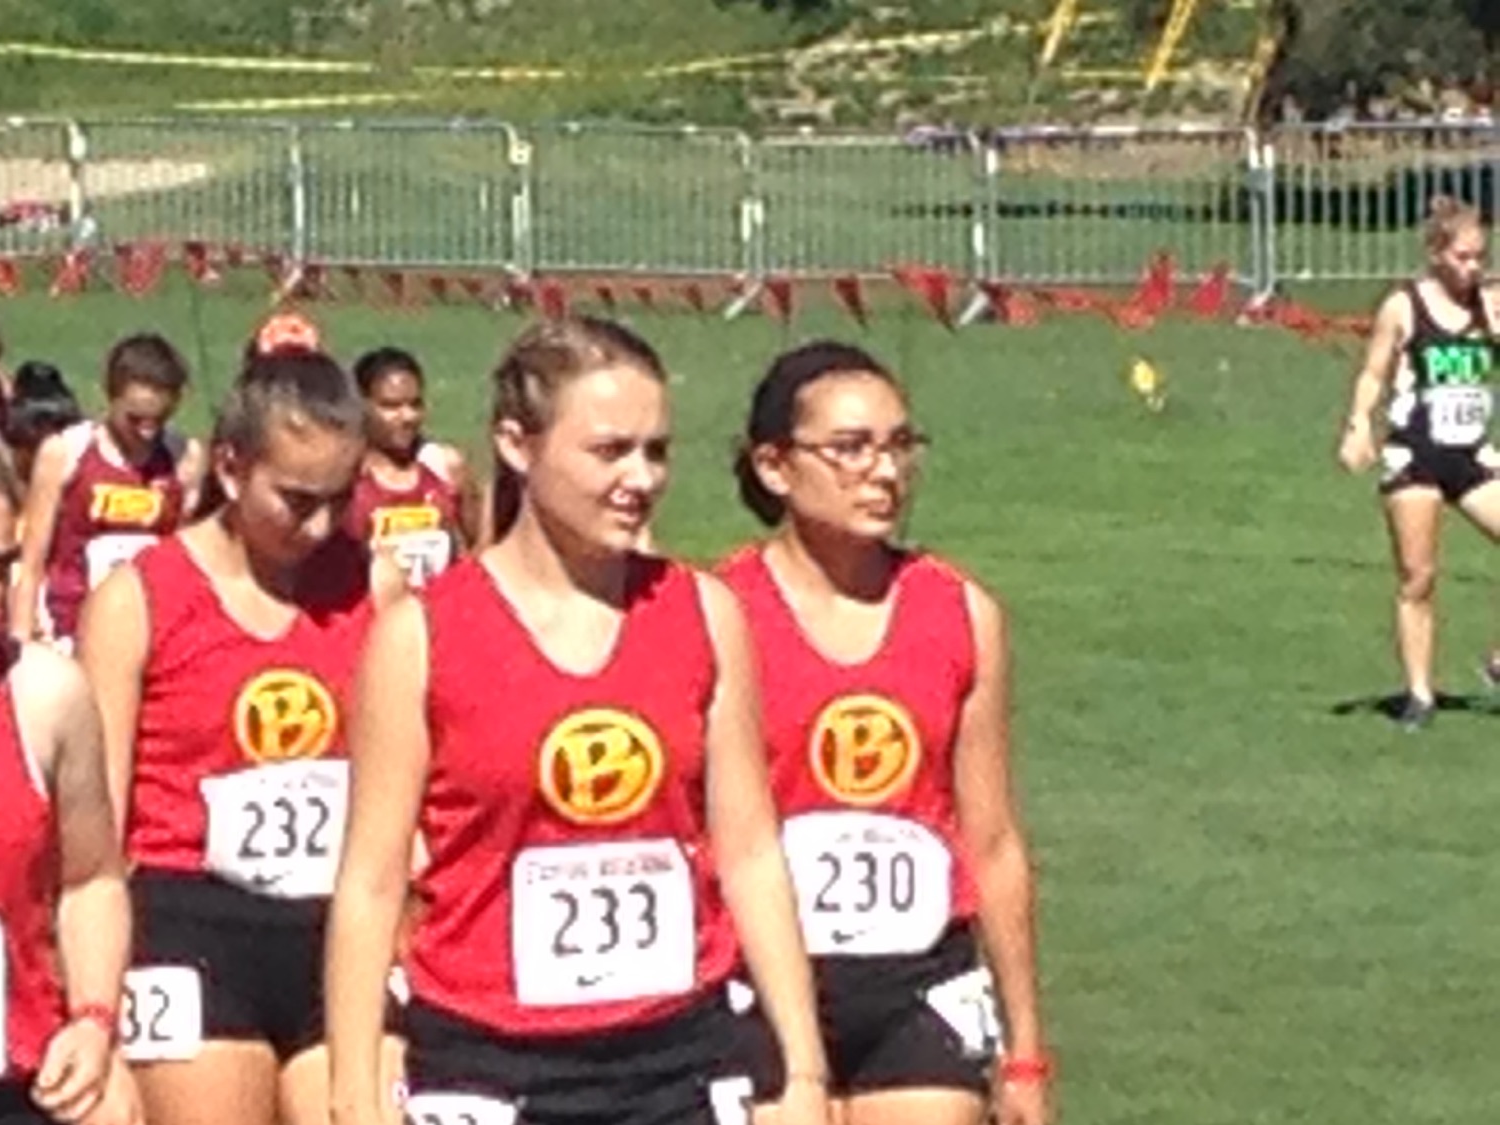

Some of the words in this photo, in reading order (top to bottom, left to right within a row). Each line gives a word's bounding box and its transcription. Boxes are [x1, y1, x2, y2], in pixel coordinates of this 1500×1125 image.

[555, 724, 652, 813] B
[825, 708, 909, 794] B
[237, 797, 329, 859] 232
[550, 881, 658, 957] 233
[813, 852, 915, 912] 230
